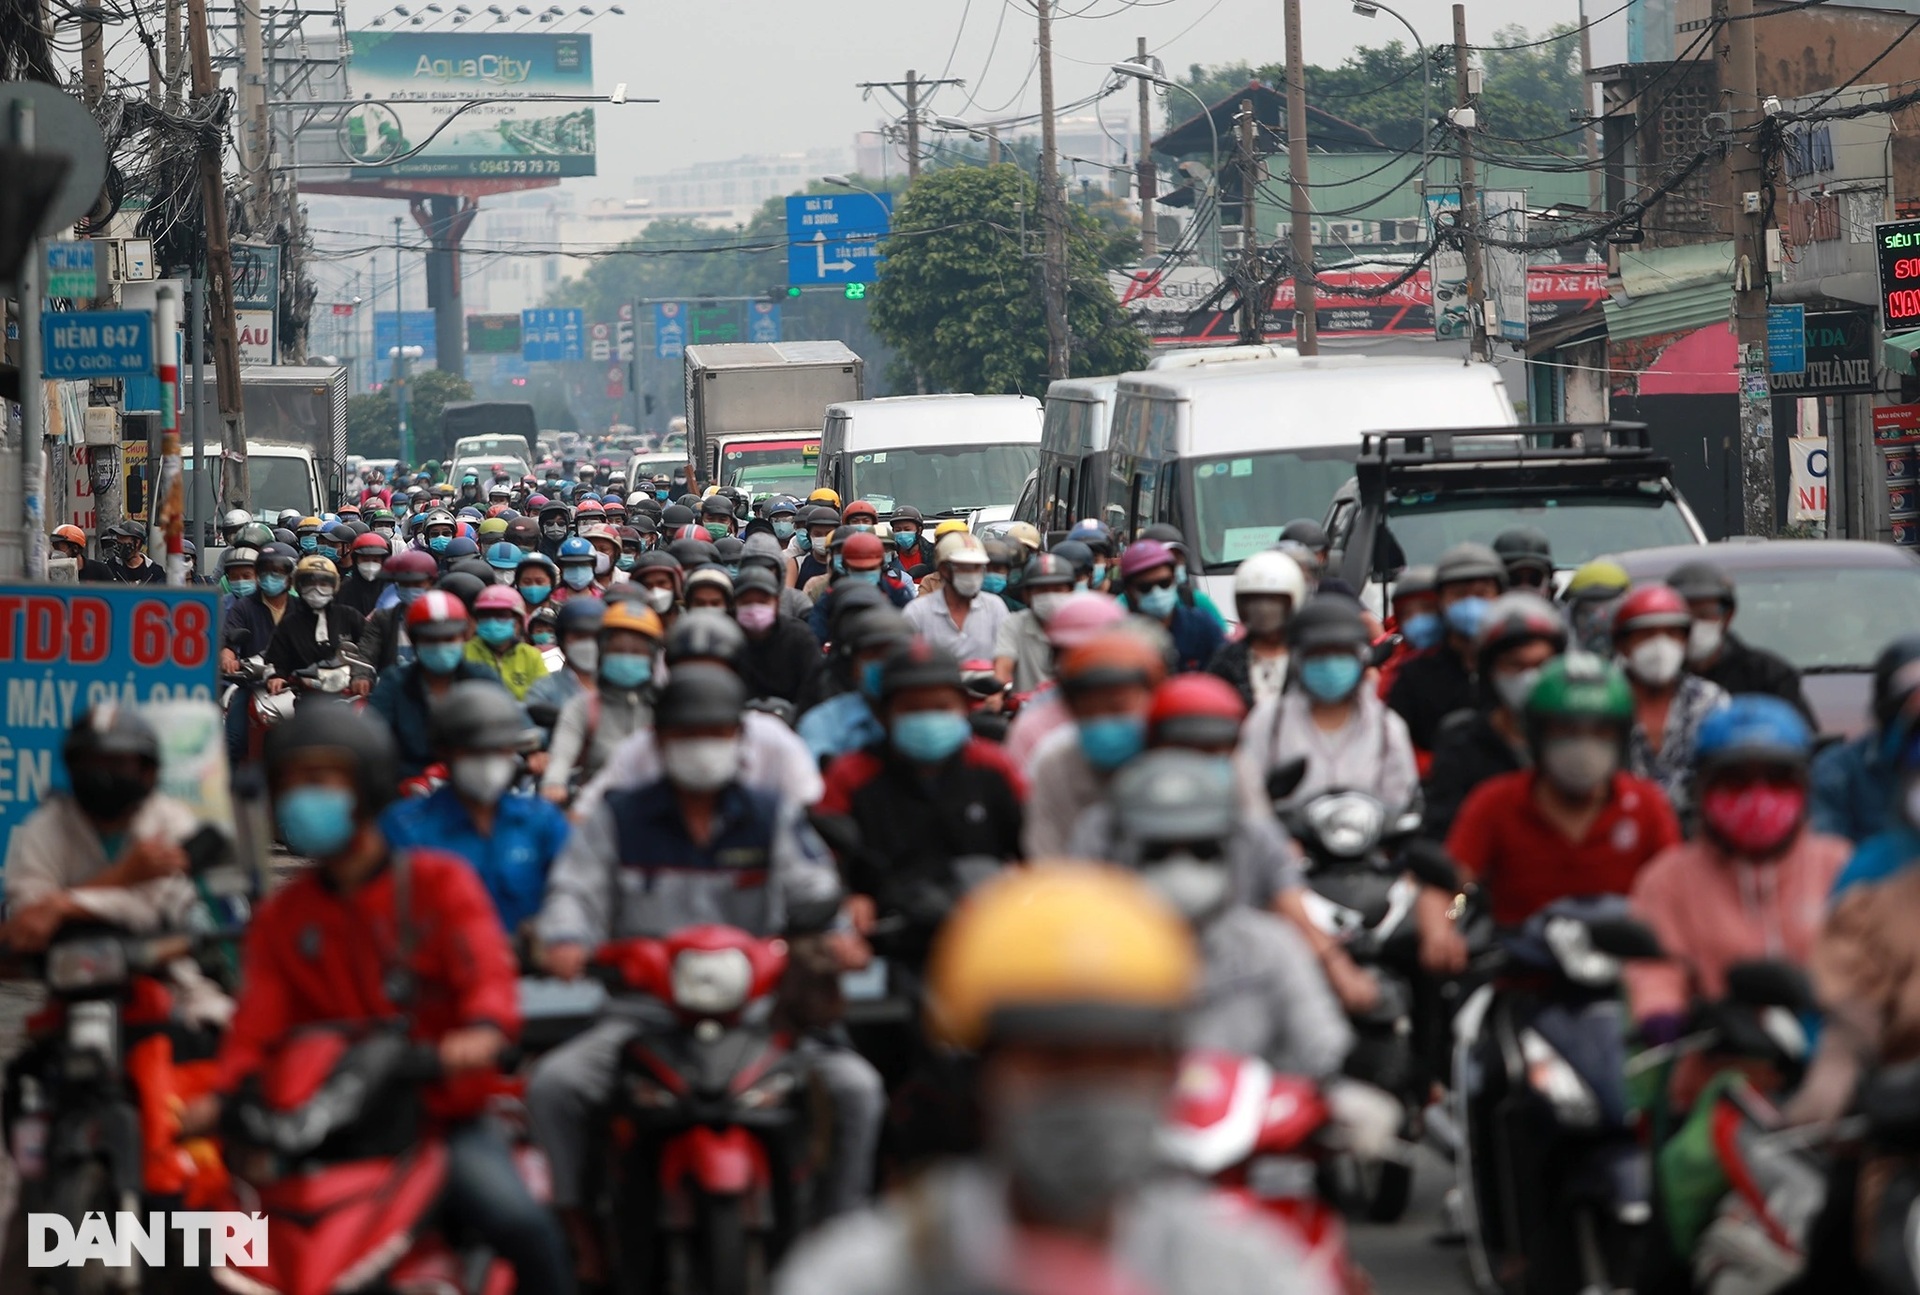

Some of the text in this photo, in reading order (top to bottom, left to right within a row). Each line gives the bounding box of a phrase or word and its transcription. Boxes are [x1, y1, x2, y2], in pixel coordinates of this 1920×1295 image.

[414, 54, 531, 82] AquaCity
[511, 160, 526, 173] 79
[529, 160, 544, 173] 79
[546, 160, 561, 173] 79
[1885, 233, 1911, 249] SIÊU
[54, 320, 140, 349] HẺM 647
[1821, 328, 1846, 347] DA
[54, 354, 75, 372] LỘ
[120, 354, 143, 369] 4M
[1807, 354, 1870, 387] THÀNH
[131, 599, 209, 669] 68
[7, 669, 78, 729] MÁY
